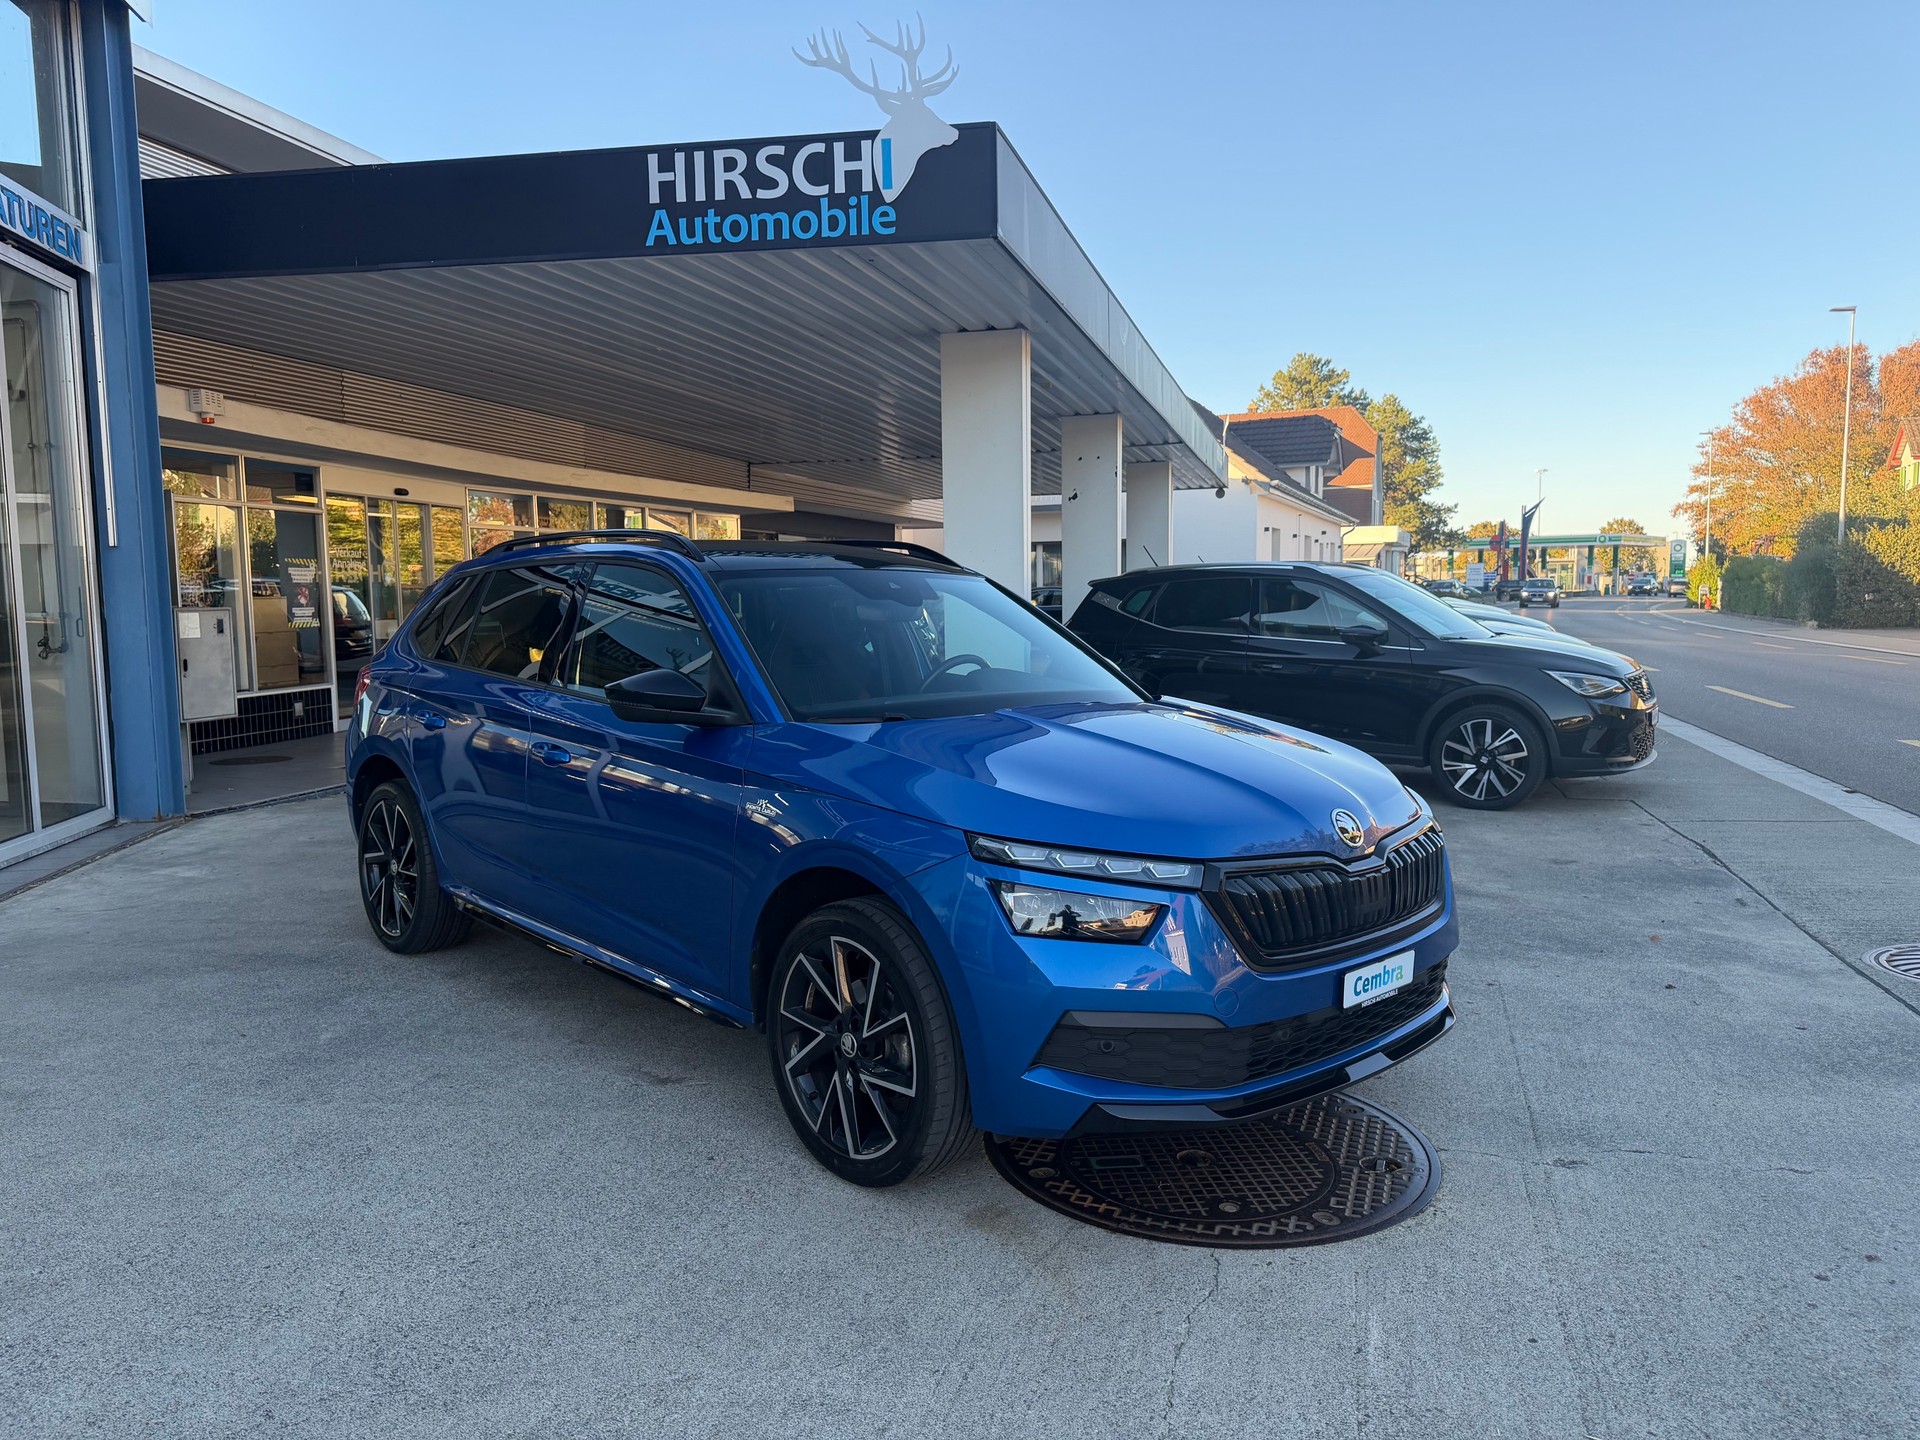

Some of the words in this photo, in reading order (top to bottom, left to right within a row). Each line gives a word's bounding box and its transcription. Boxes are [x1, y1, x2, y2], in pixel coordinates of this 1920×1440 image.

[647, 138, 893, 204] HIRSCHI
[645, 194, 897, 246] Automobile
[335, 547, 362, 558] Verkauf
[1353, 964, 1404, 997] Cembra
